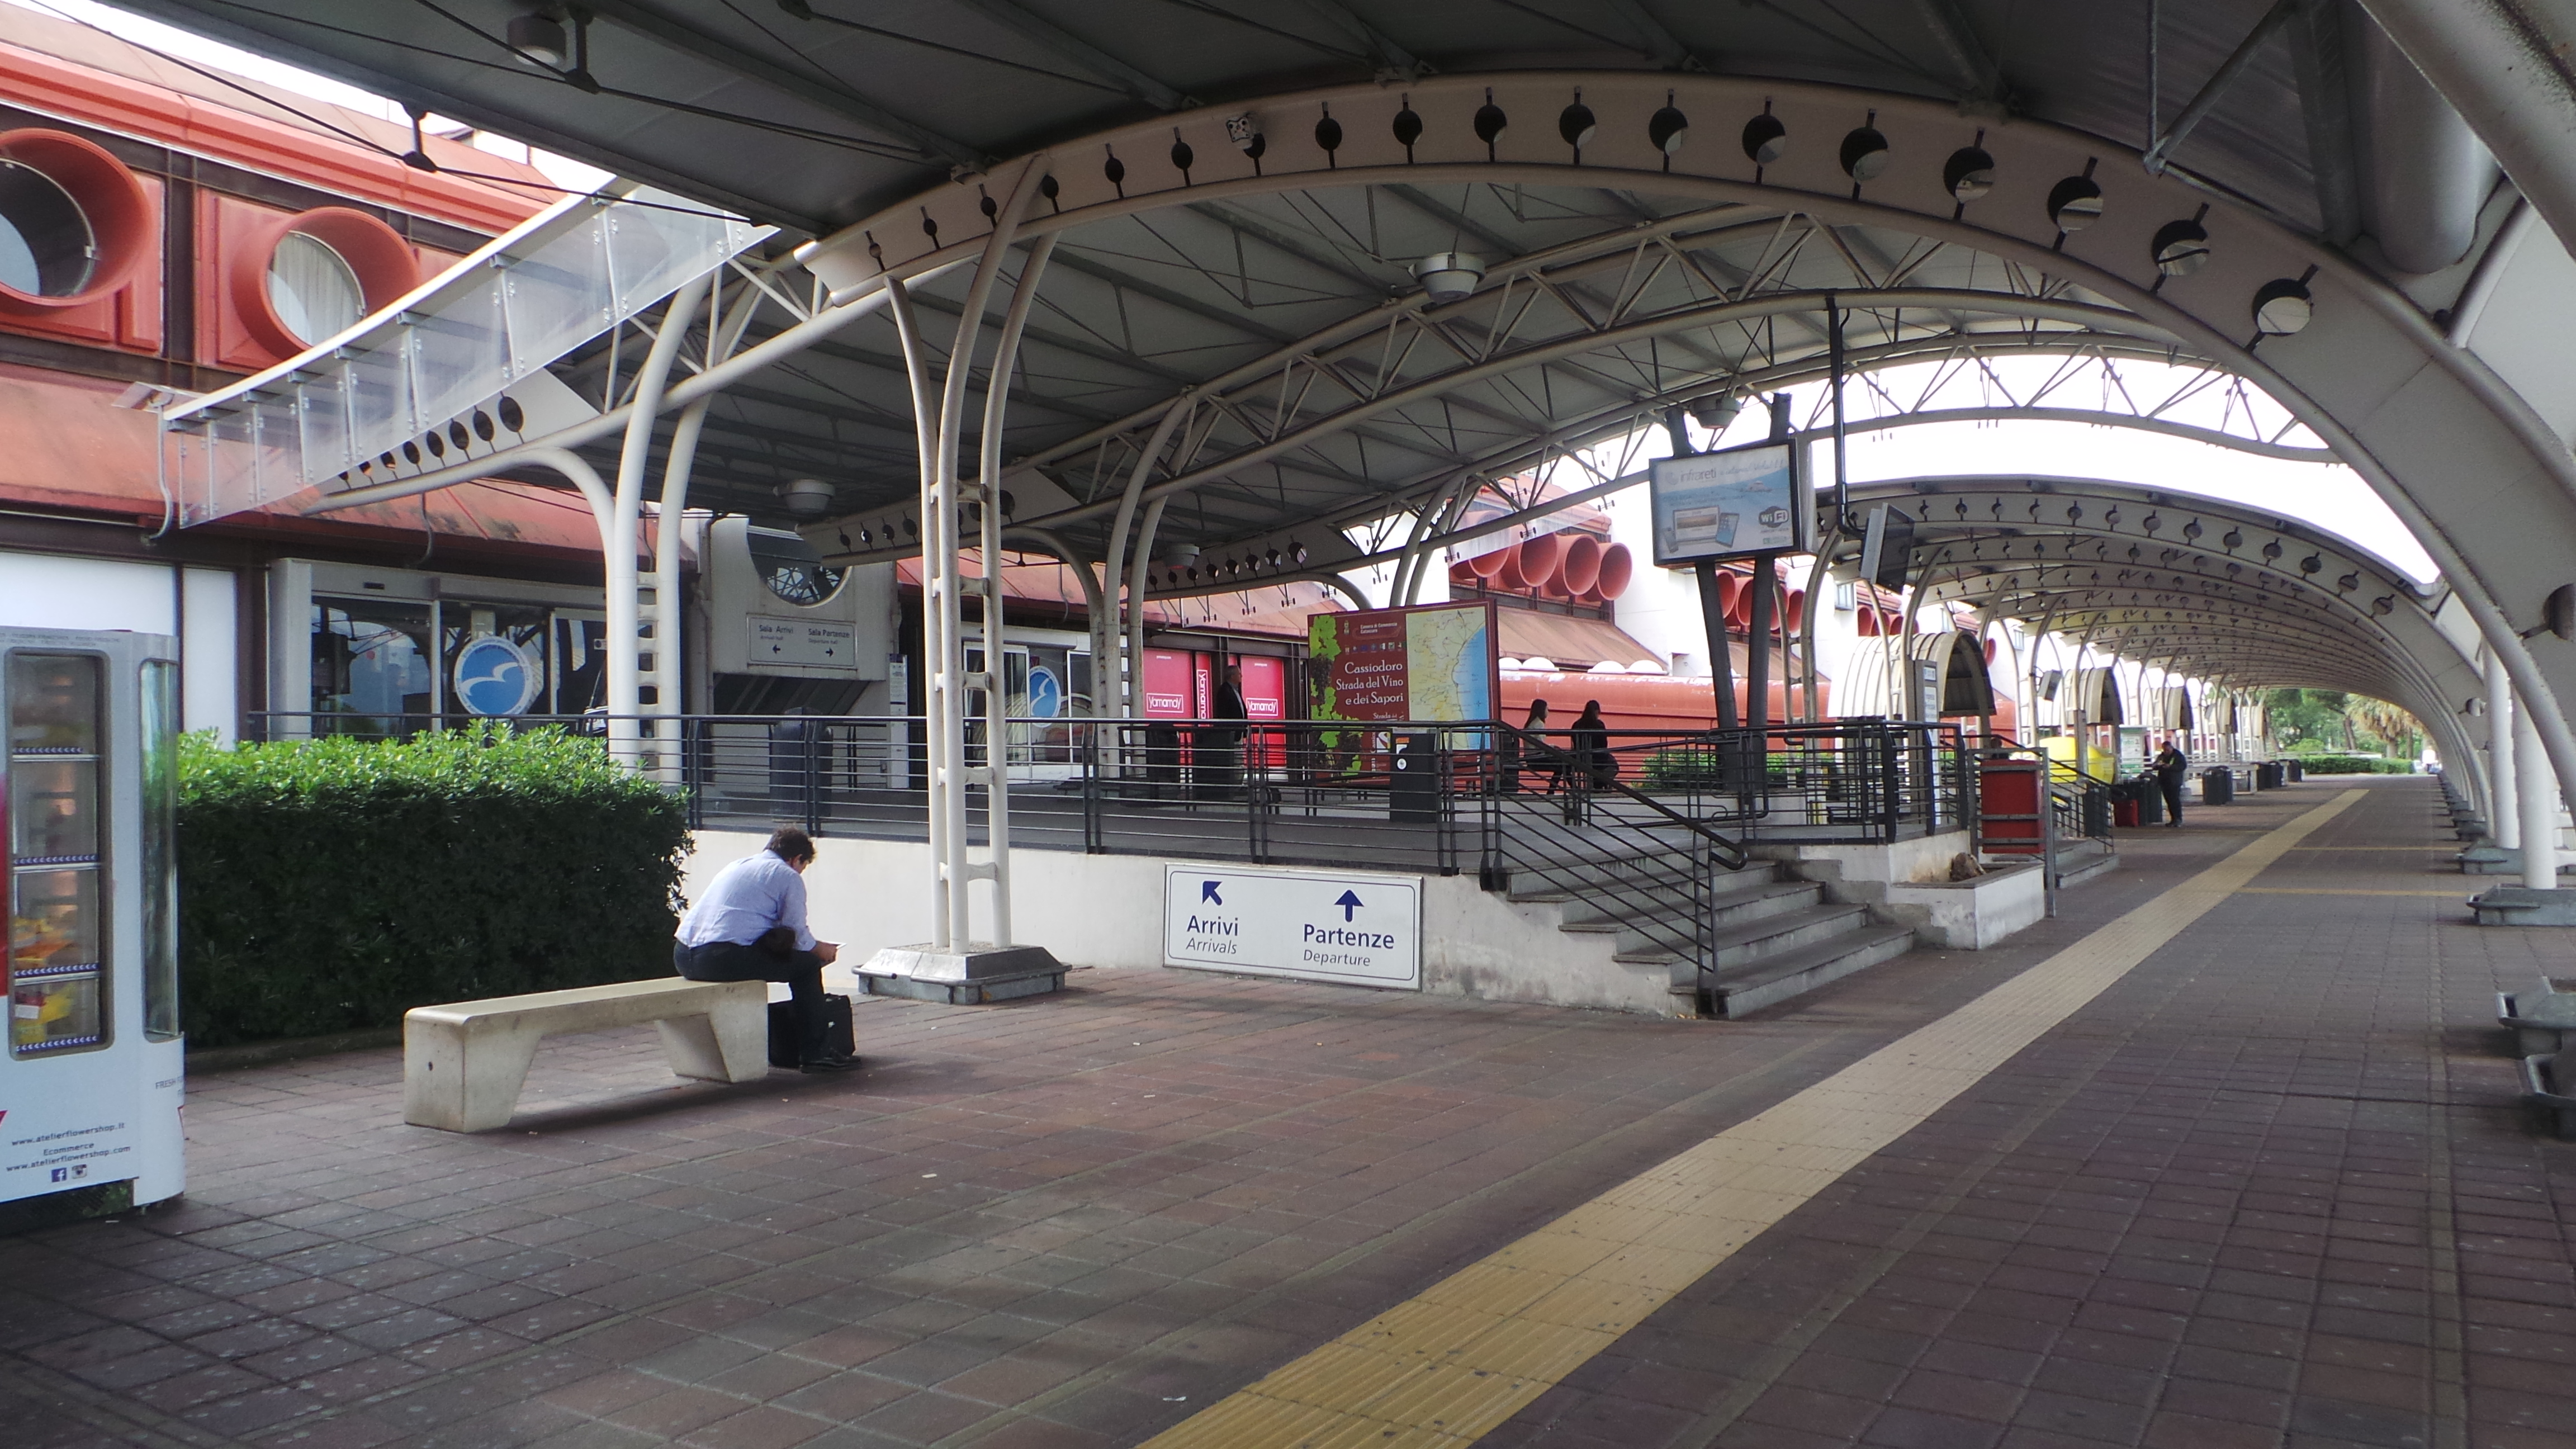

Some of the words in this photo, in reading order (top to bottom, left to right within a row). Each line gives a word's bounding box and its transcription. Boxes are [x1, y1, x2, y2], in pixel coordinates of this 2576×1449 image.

[1680, 468, 1716, 482] infrareti
[776, 626, 793, 634] Arrivi
[822, 629, 850, 638] Partenze
[1344, 660, 1403, 674] Cassiodoro
[1336, 678, 1364, 690] Strada
[1366, 676, 1380, 688] del
[1381, 675, 1403, 686] Vino
[1353, 693, 1369, 704] dei
[1371, 691, 1404, 705] Sapori
[1186, 915, 1239, 937] Arrivi
[1303, 924, 1395, 949] Partenze
[1186, 937, 1237, 955] Arrivals
[1303, 950, 1371, 967] Departure
[12, 1123, 125, 1145] www.atelierflowershop.it
[44, 1142, 94, 1156] Ecommerce
[6, 1146, 131, 1172] www.atelierflowershop.com
